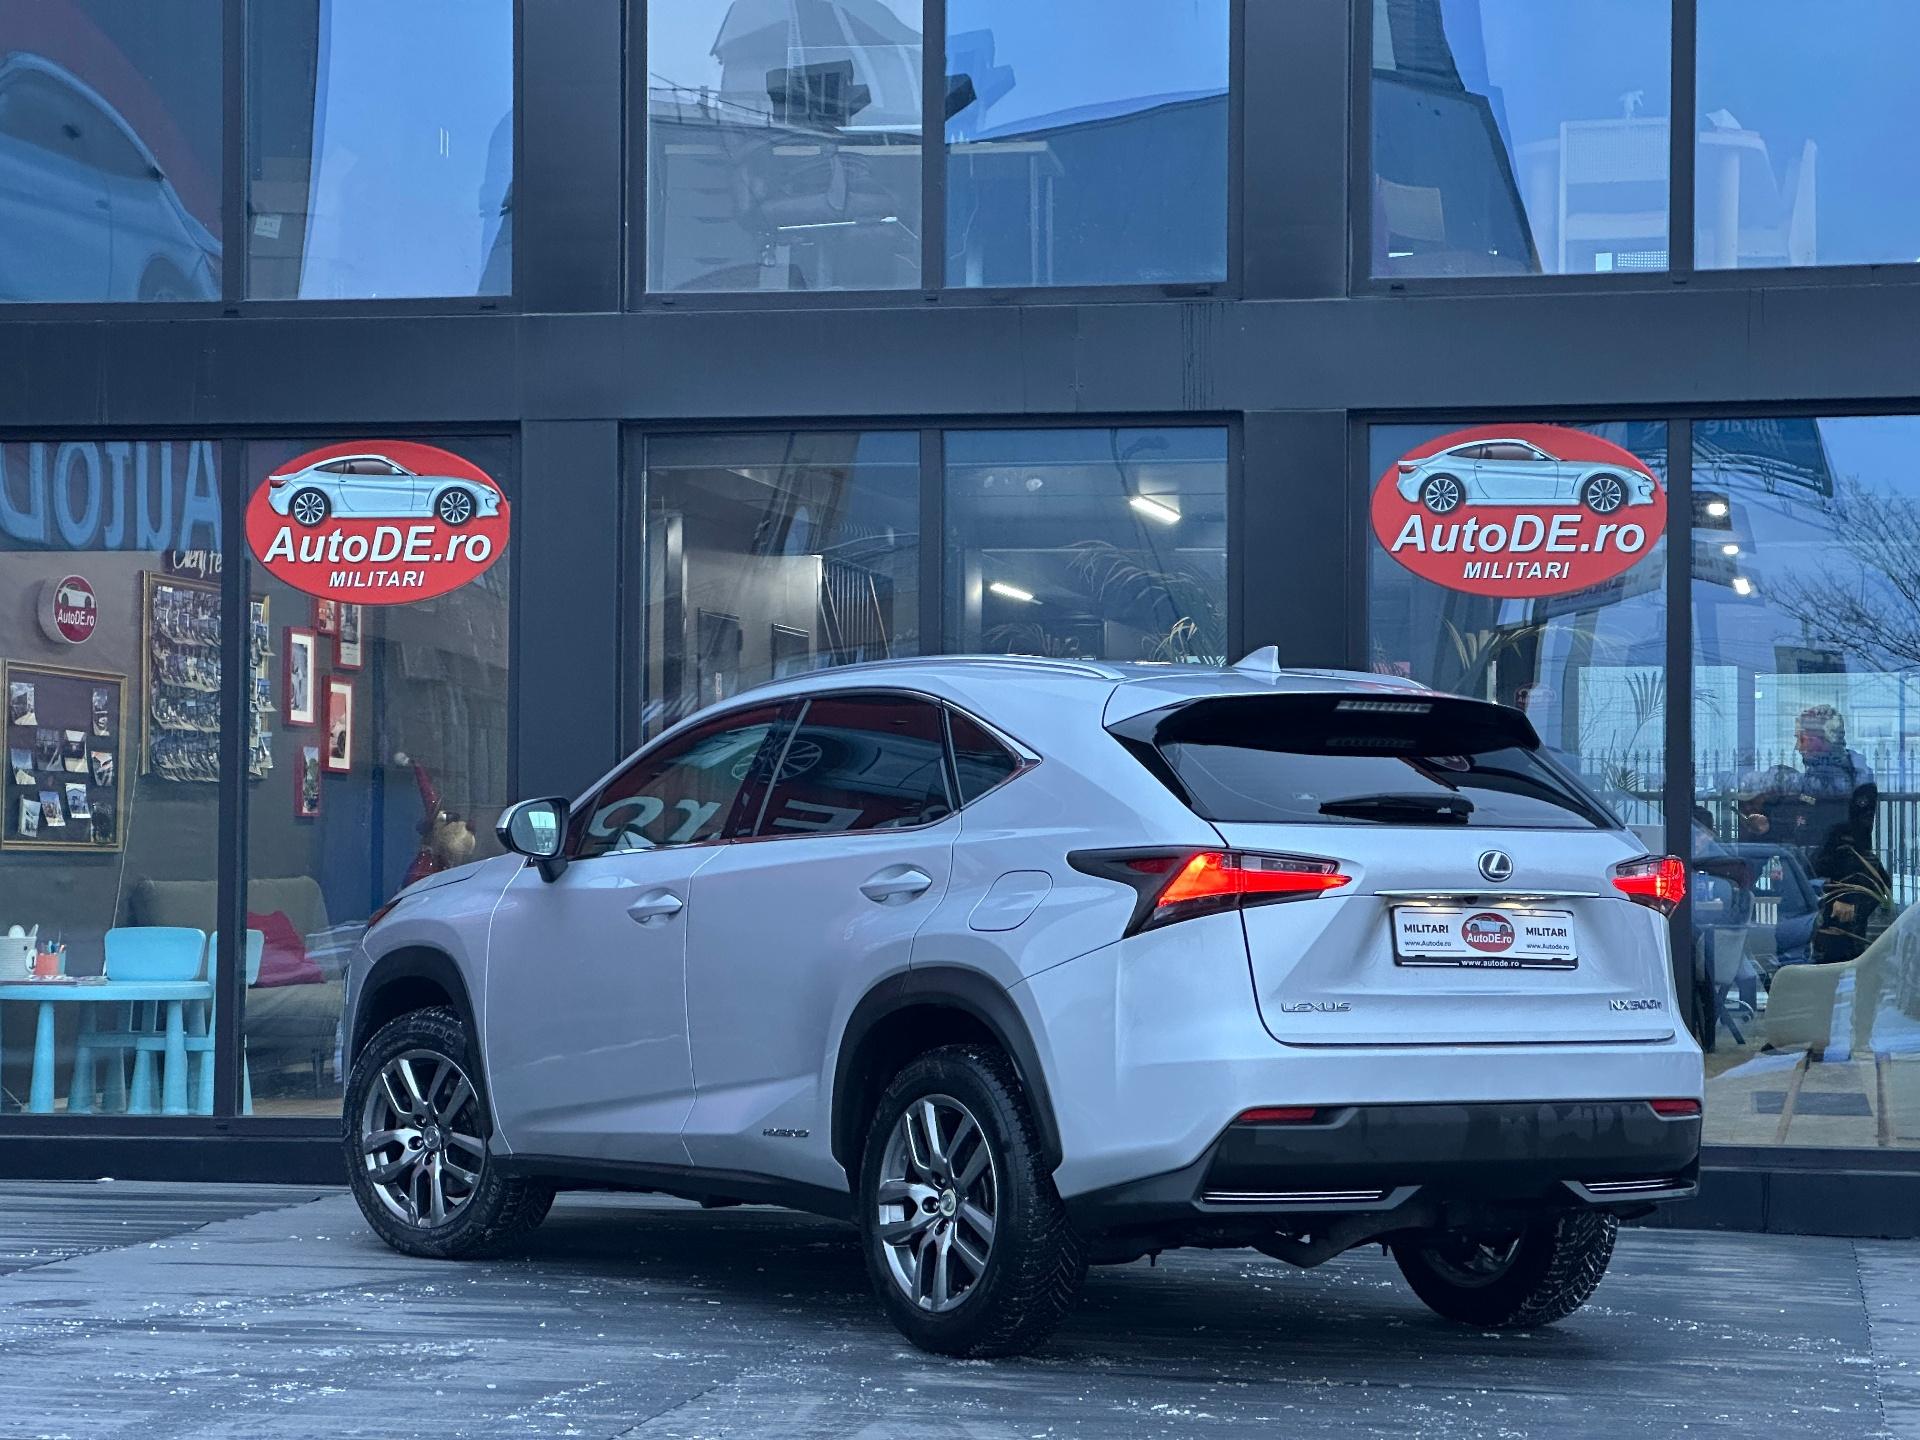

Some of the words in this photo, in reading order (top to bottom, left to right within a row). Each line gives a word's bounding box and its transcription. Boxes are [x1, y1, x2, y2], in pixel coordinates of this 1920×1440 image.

[1391, 514, 1647, 554] AutoDE.ro
[264, 525, 492, 564] AutoDE.ro
[1463, 560, 1570, 580] MILITARI
[329, 570, 425, 588] MILITARI
[57, 608, 95, 627] AutoDE.ro
[1404, 924, 1449, 934] MILITARI
[1525, 927, 1567, 938] MILITARI
[1466, 932, 1513, 944] AutoDE.ro
[1526, 943, 1570, 951] www.Autode.ro
[1461, 959, 1519, 968] www.autode.ro
[1281, 1002, 1351, 1012] LEXUS
